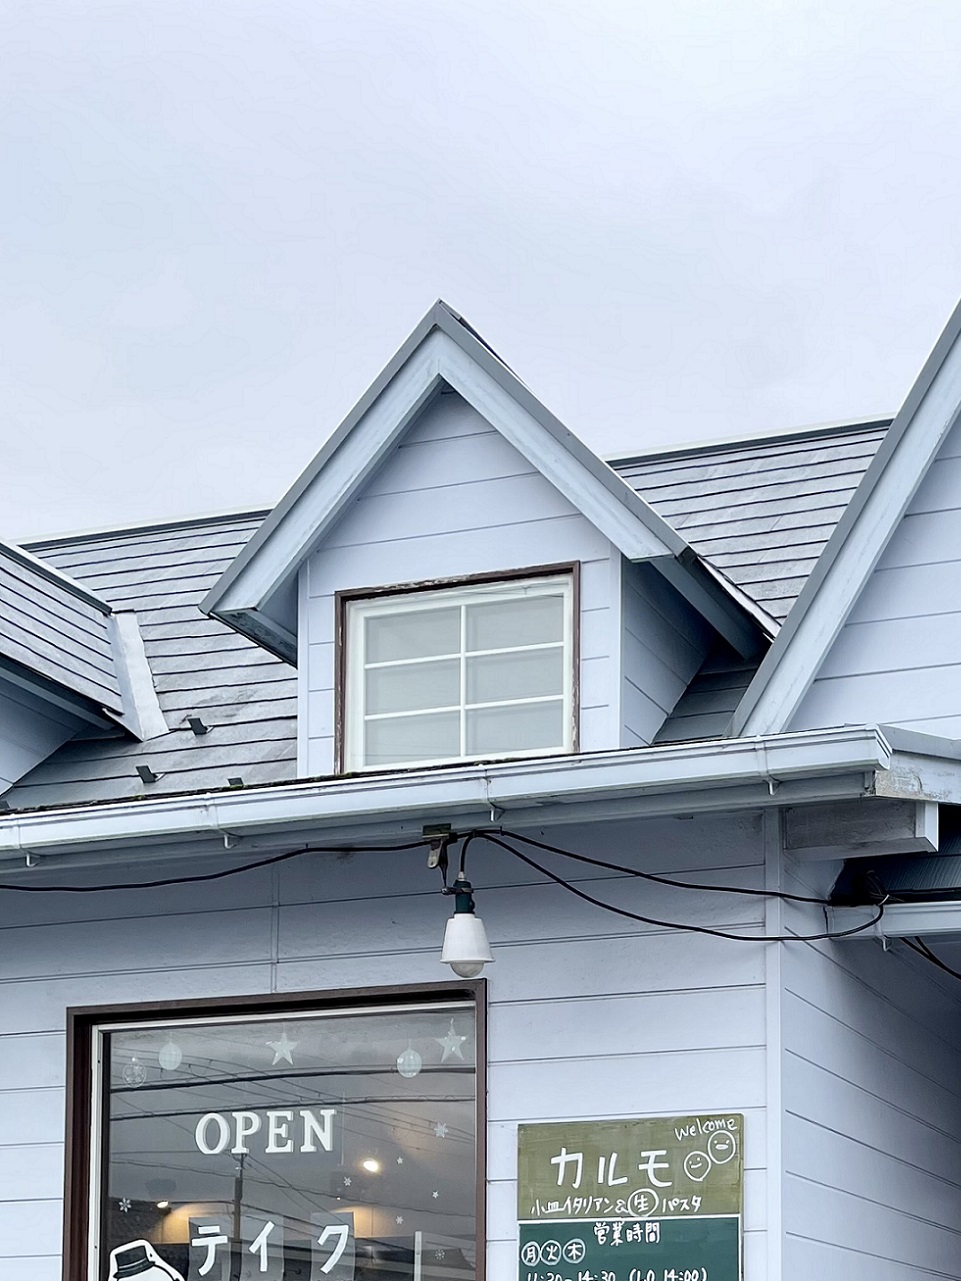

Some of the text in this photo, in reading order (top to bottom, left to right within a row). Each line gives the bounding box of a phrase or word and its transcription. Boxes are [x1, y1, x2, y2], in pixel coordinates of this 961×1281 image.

[195, 1109, 337, 1155] OPEN
[551, 1148, 672, 1189] カルモ
[594, 1221, 661, 1246] 営業時間
